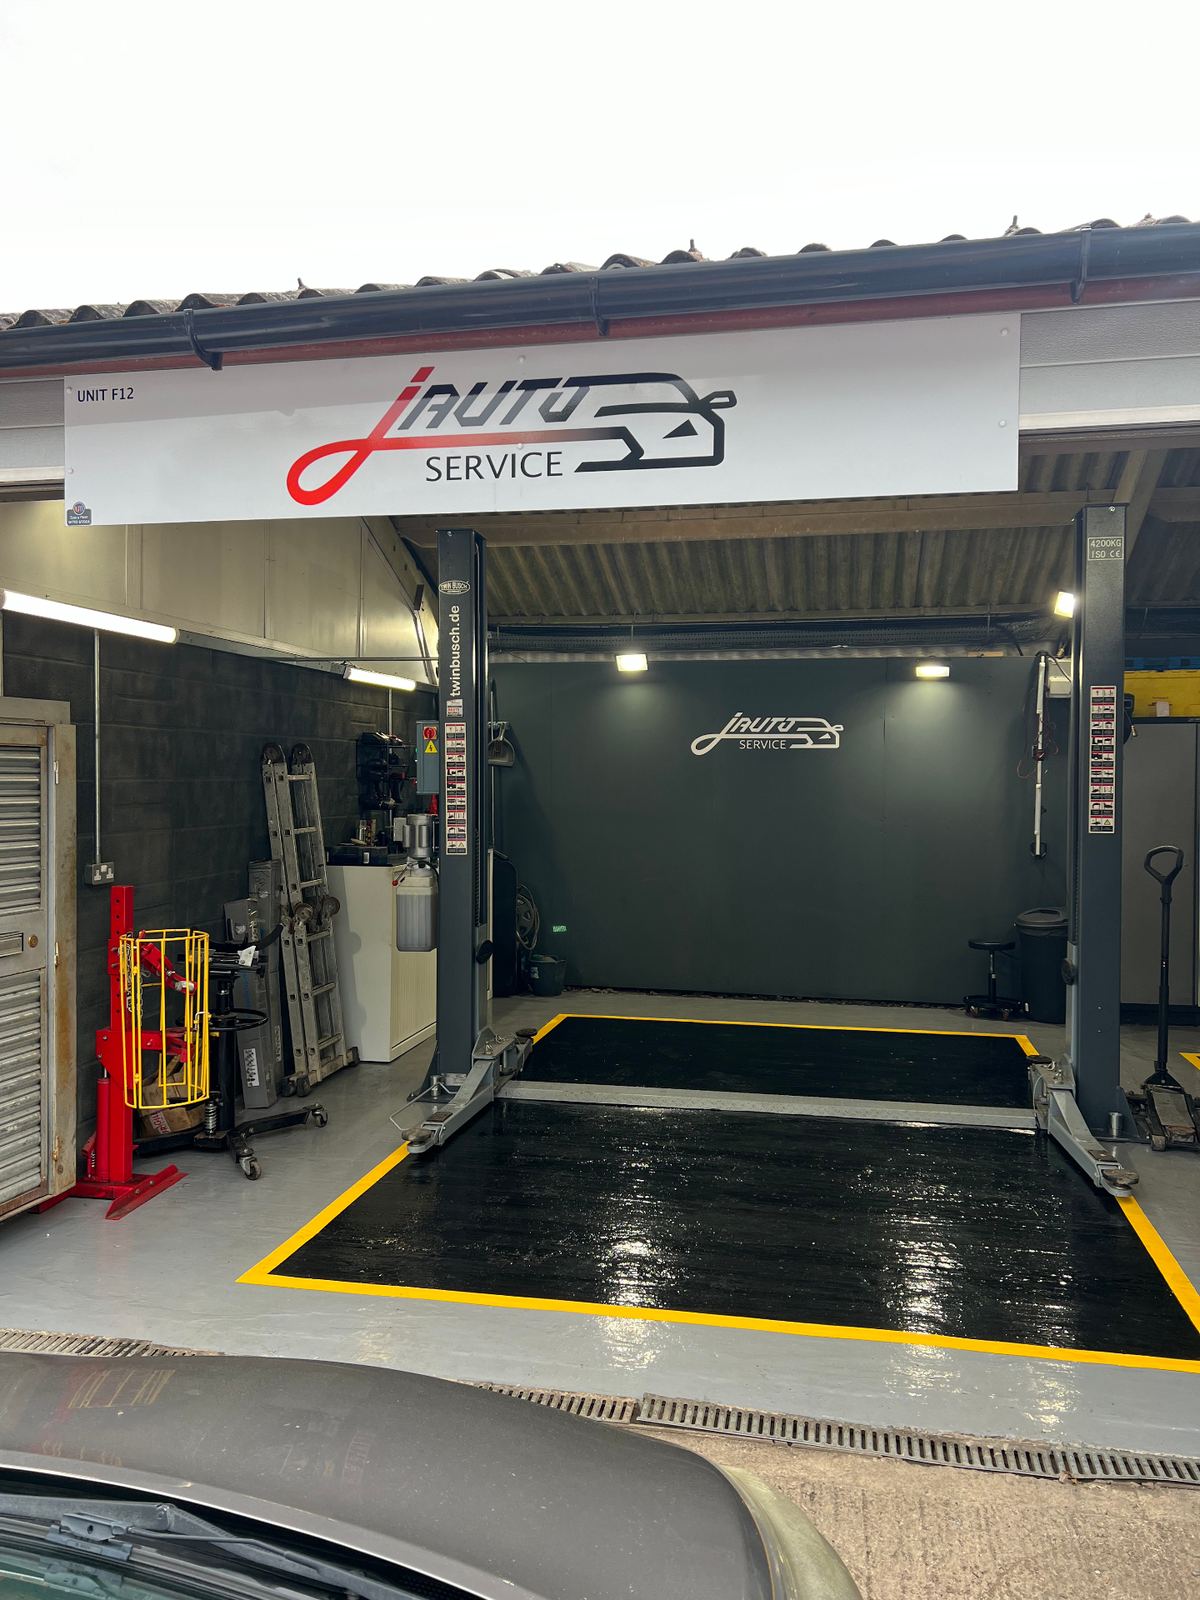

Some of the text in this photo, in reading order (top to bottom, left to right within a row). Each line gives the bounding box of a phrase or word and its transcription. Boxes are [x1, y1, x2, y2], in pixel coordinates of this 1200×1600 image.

[77, 387, 134, 402] UNIT F12
[425, 450, 564, 482] SERVICE
[1090, 539, 1121, 547] 4200KG
[1091, 550, 1106, 559] ISO
[448, 604, 461, 697] twinbusch.de
[739, 739, 787, 750] SERVICE
